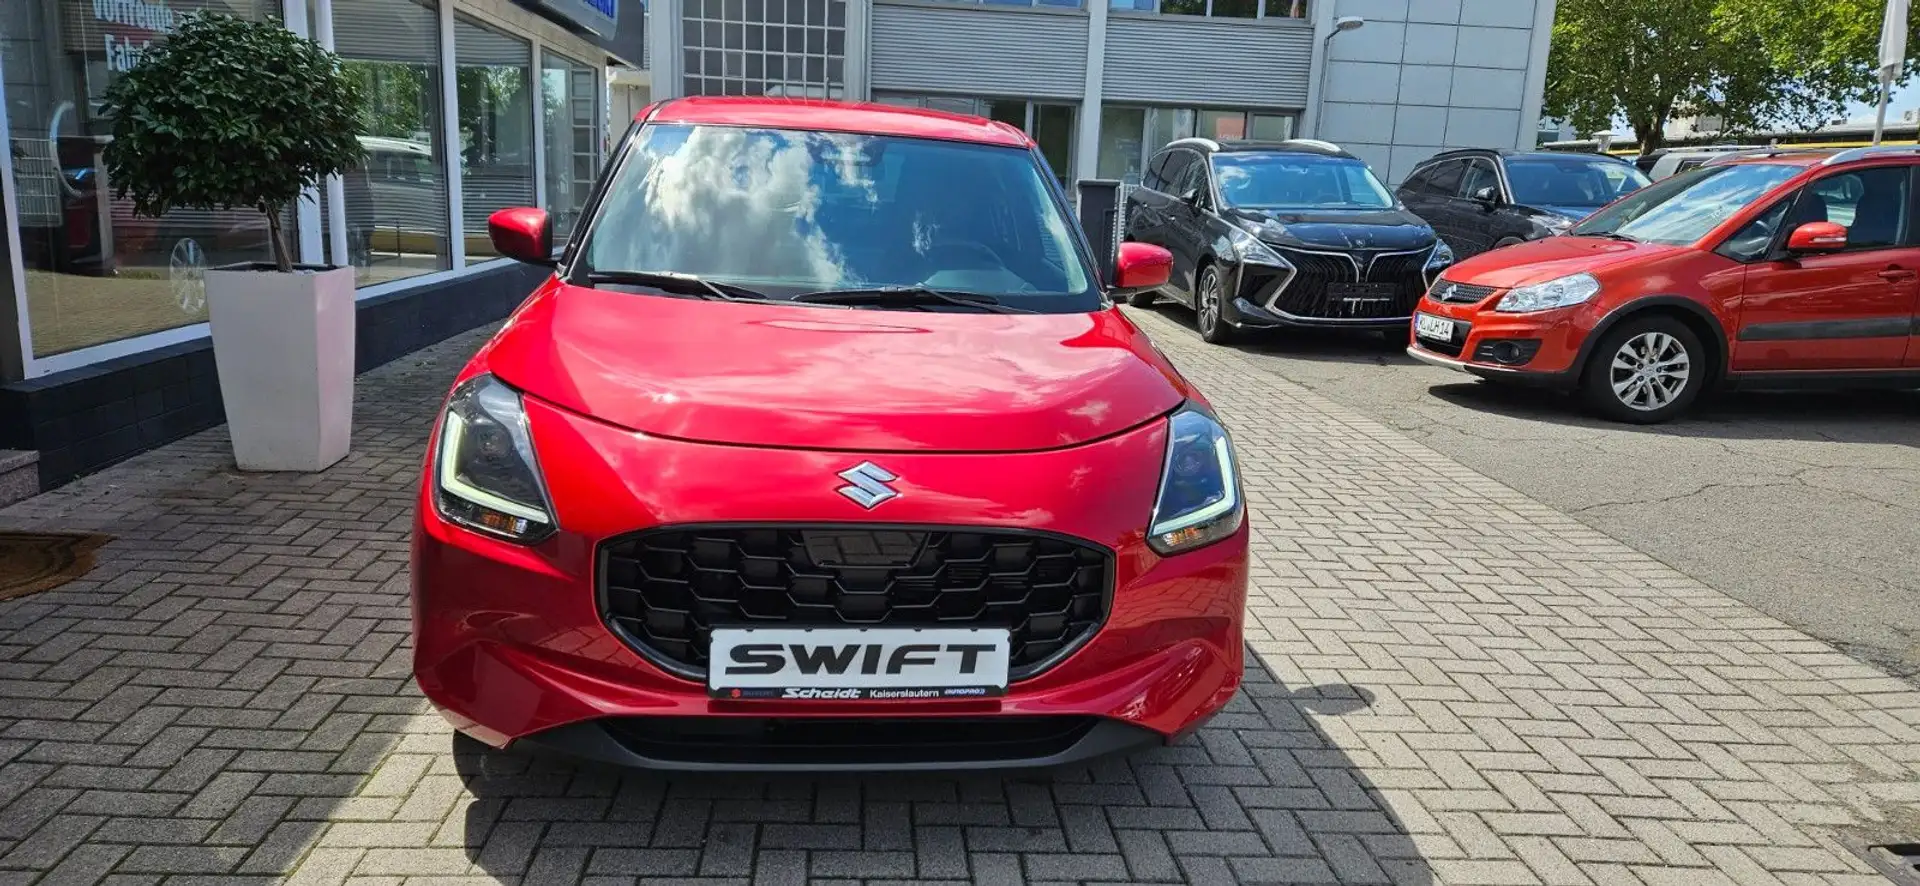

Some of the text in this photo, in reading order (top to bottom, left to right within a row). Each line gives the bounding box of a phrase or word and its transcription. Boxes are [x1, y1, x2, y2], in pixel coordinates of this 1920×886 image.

[725, 644, 997, 675] SWIFT
[782, 688, 861, 698] Scheidt
[870, 689, 939, 698] Kaiserslautern
